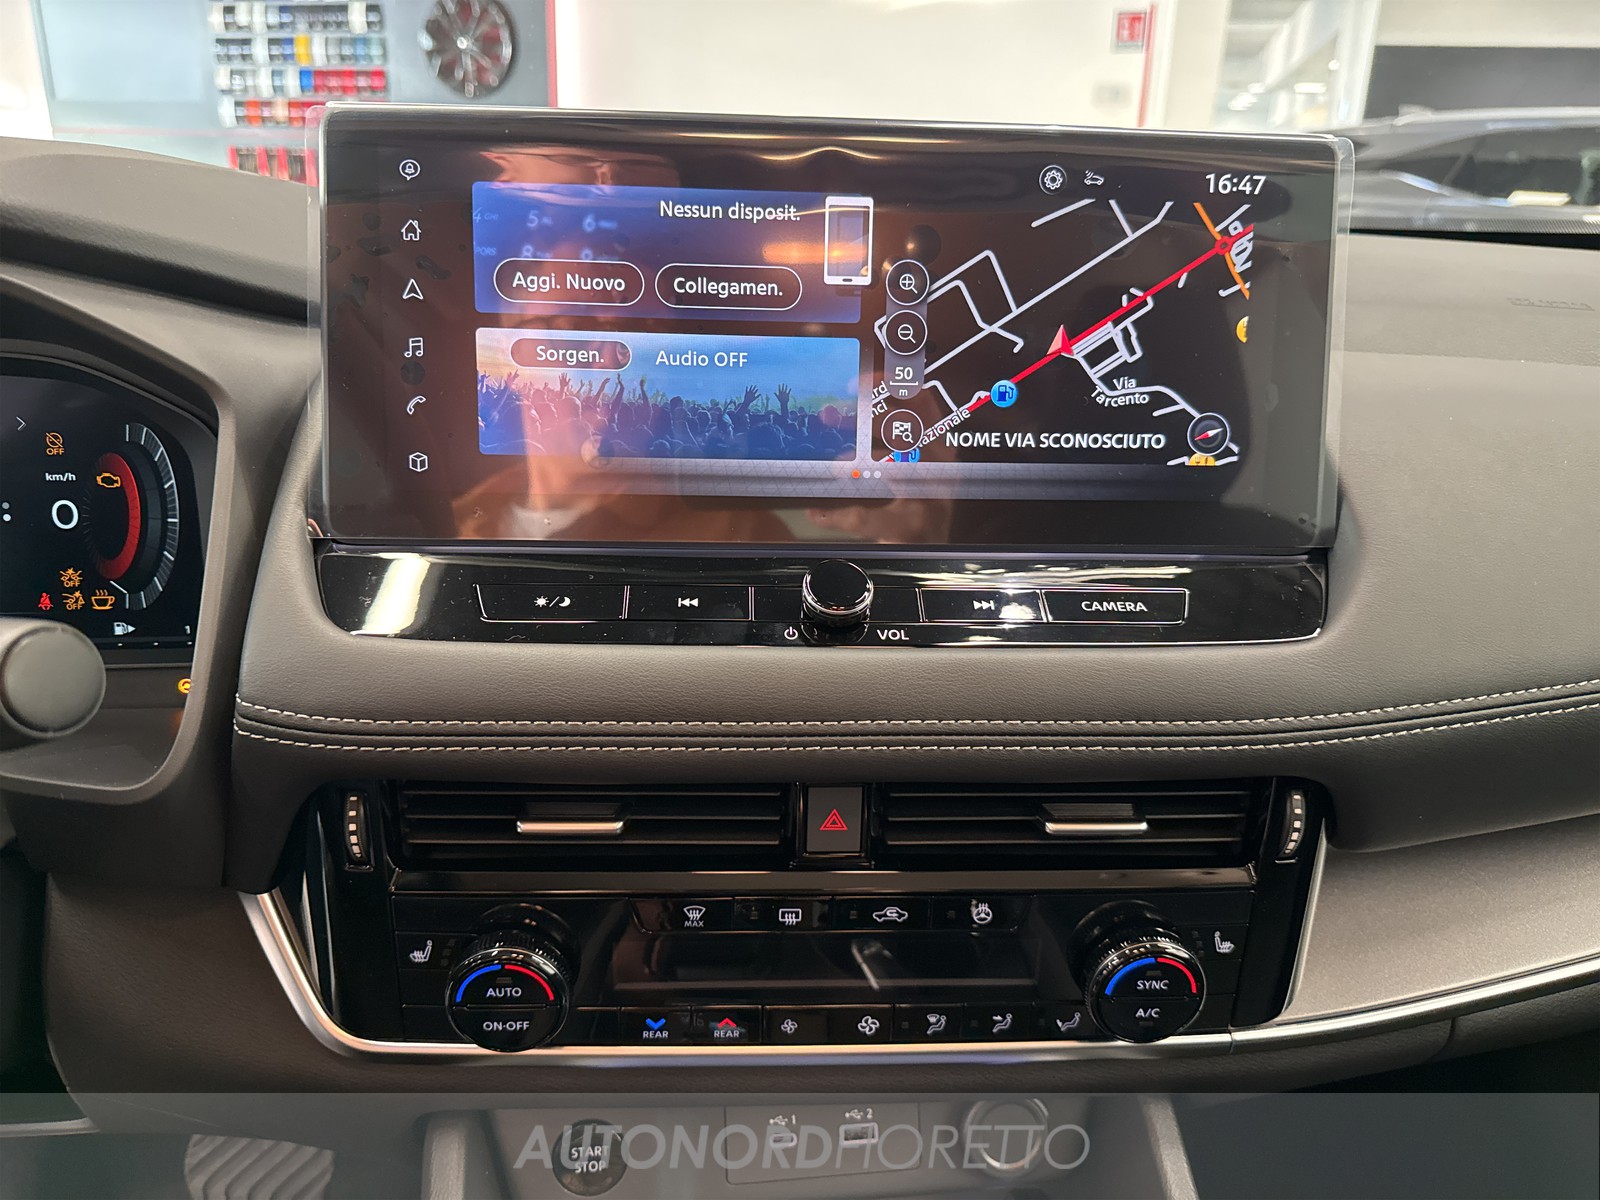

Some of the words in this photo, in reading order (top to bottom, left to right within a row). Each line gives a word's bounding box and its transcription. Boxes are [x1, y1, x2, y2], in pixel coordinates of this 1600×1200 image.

[1206, 173, 1267, 195] 16:47
[527, 210, 539, 228] 5
[659, 200, 723, 222] Nessun
[728, 202, 801, 224] disposit.
[582, 213, 596, 232] 6
[512, 271, 561, 292] Aggi.
[566, 273, 626, 292] Nuovo
[673, 277, 784, 298] Collegamen.
[536, 344, 605, 367] Sorgen.
[655, 350, 709, 369] Audio
[715, 351, 749, 369] OFF
[894, 366, 914, 381] 50
[1112, 376, 1137, 390] Via
[899, 388, 908, 397] m
[1091, 386, 1150, 407] Tarcento
[919, 406, 972, 448] azionale
[945, 432, 1000, 449] NOME
[1005, 433, 1035, 449] VIA
[1039, 433, 1166, 450] SCONOSCIUTO
[46, 448, 65, 456] OFF
[45, 472, 77, 483] km/h
[51, 499, 79, 530] 0
[63, 580, 80, 588] OFF
[66, 603, 82, 611] OFF
[1080, 600, 1147, 612] CAMERA
[876, 628, 909, 641] VOL
[684, 920, 704, 928] MAX
[486, 986, 522, 998] AUTO
[1136, 979, 1169, 991] SYNC
[1135, 1007, 1160, 1019] A/C
[642, 1030, 669, 1039] REAR
[713, 1030, 740, 1038] REAR
[866, 1107, 873, 1119] 2
[571, 1145, 609, 1159] START
[574, 1160, 607, 1174] STOP
